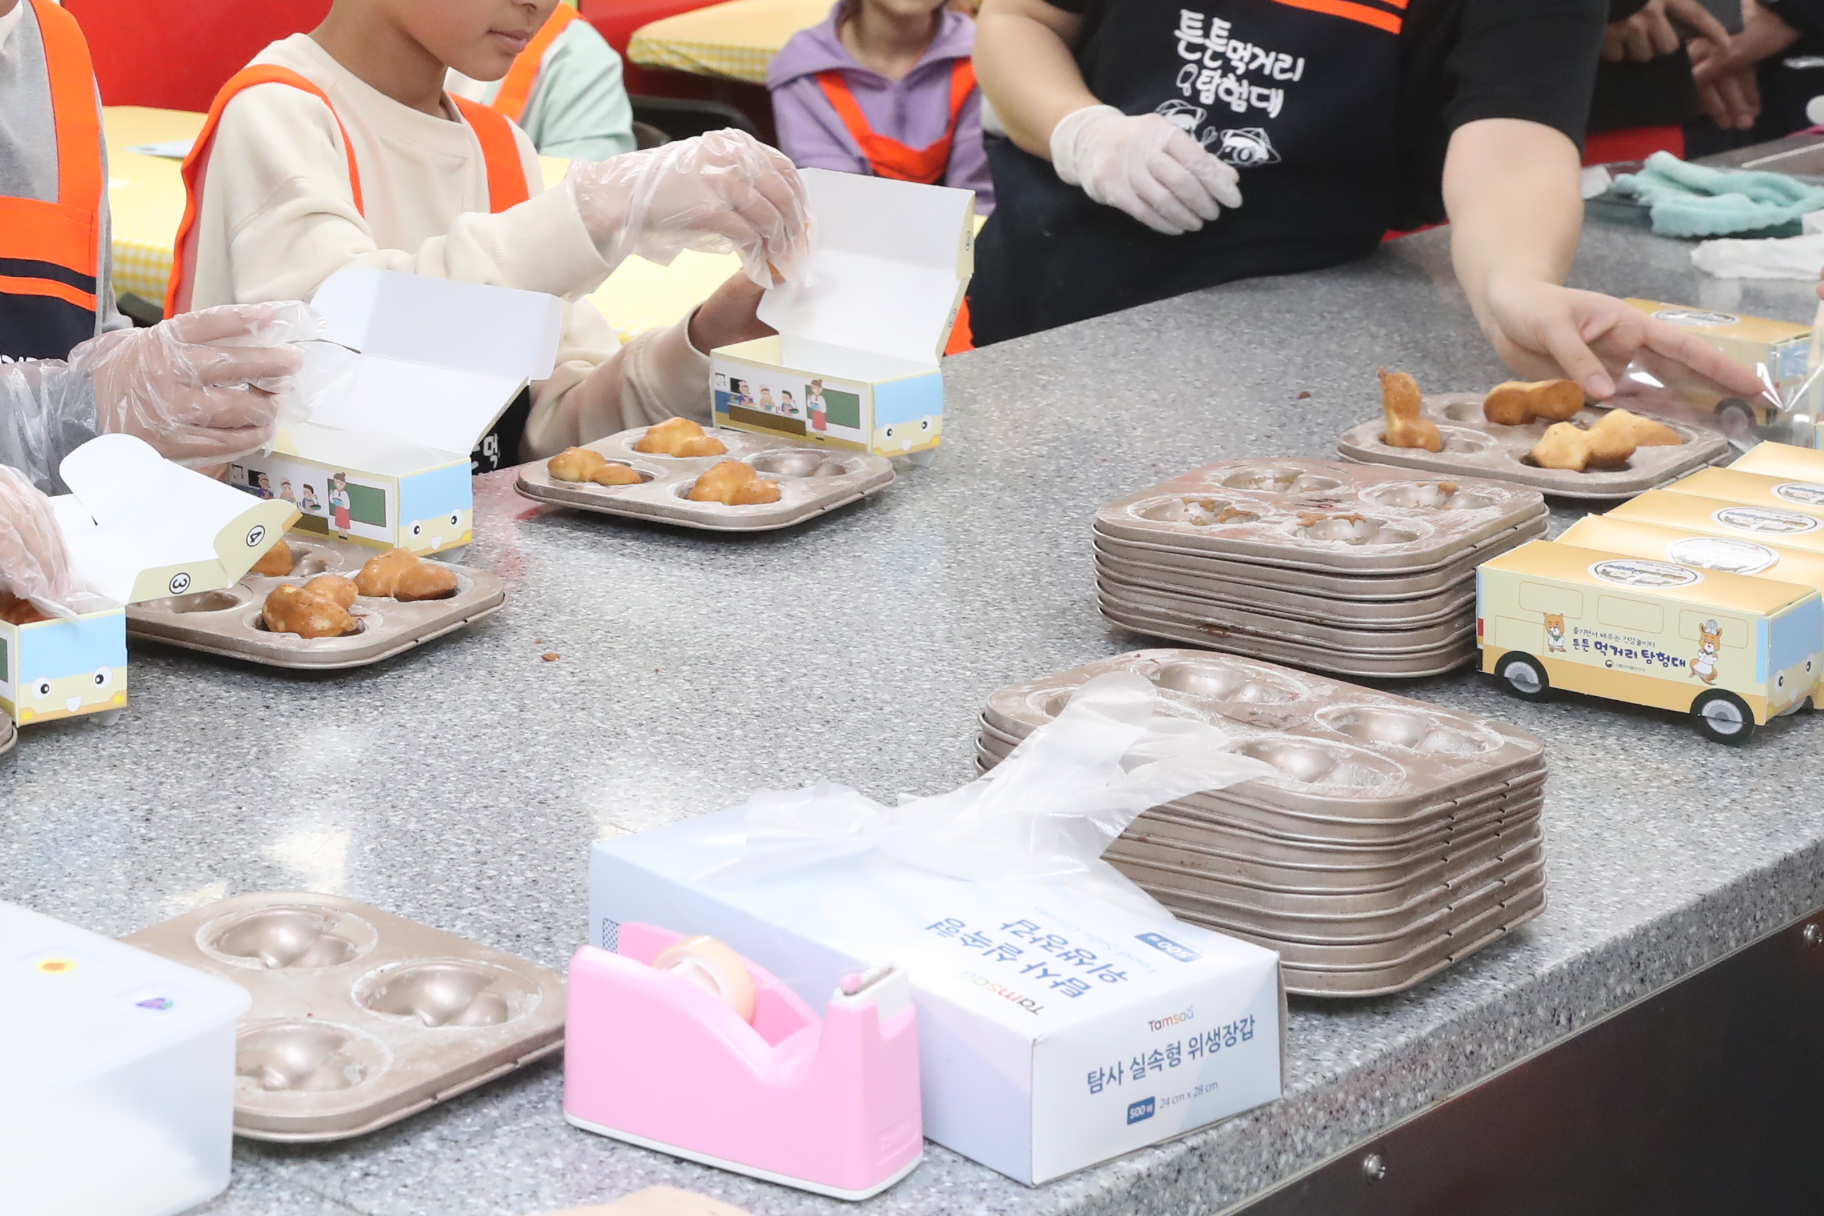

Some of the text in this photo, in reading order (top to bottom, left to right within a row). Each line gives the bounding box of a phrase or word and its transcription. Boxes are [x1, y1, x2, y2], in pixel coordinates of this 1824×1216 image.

[1196, 69, 1284, 118] 탐험대
[1572, 638, 1686, 668] 튼튼 먹거리 탐험대
[925, 917, 1093, 998] 탐사 실속형
[1000, 919, 1128, 983] 위생장갑
[1087, 1014, 1256, 1094] 탐사 실속형 위생장갑
[1159, 1096, 1170, 1109] 24
[1171, 1093, 1186, 1105] cm
[1193, 1084, 1204, 1097] 28
[1205, 1081, 1218, 1093] cm
